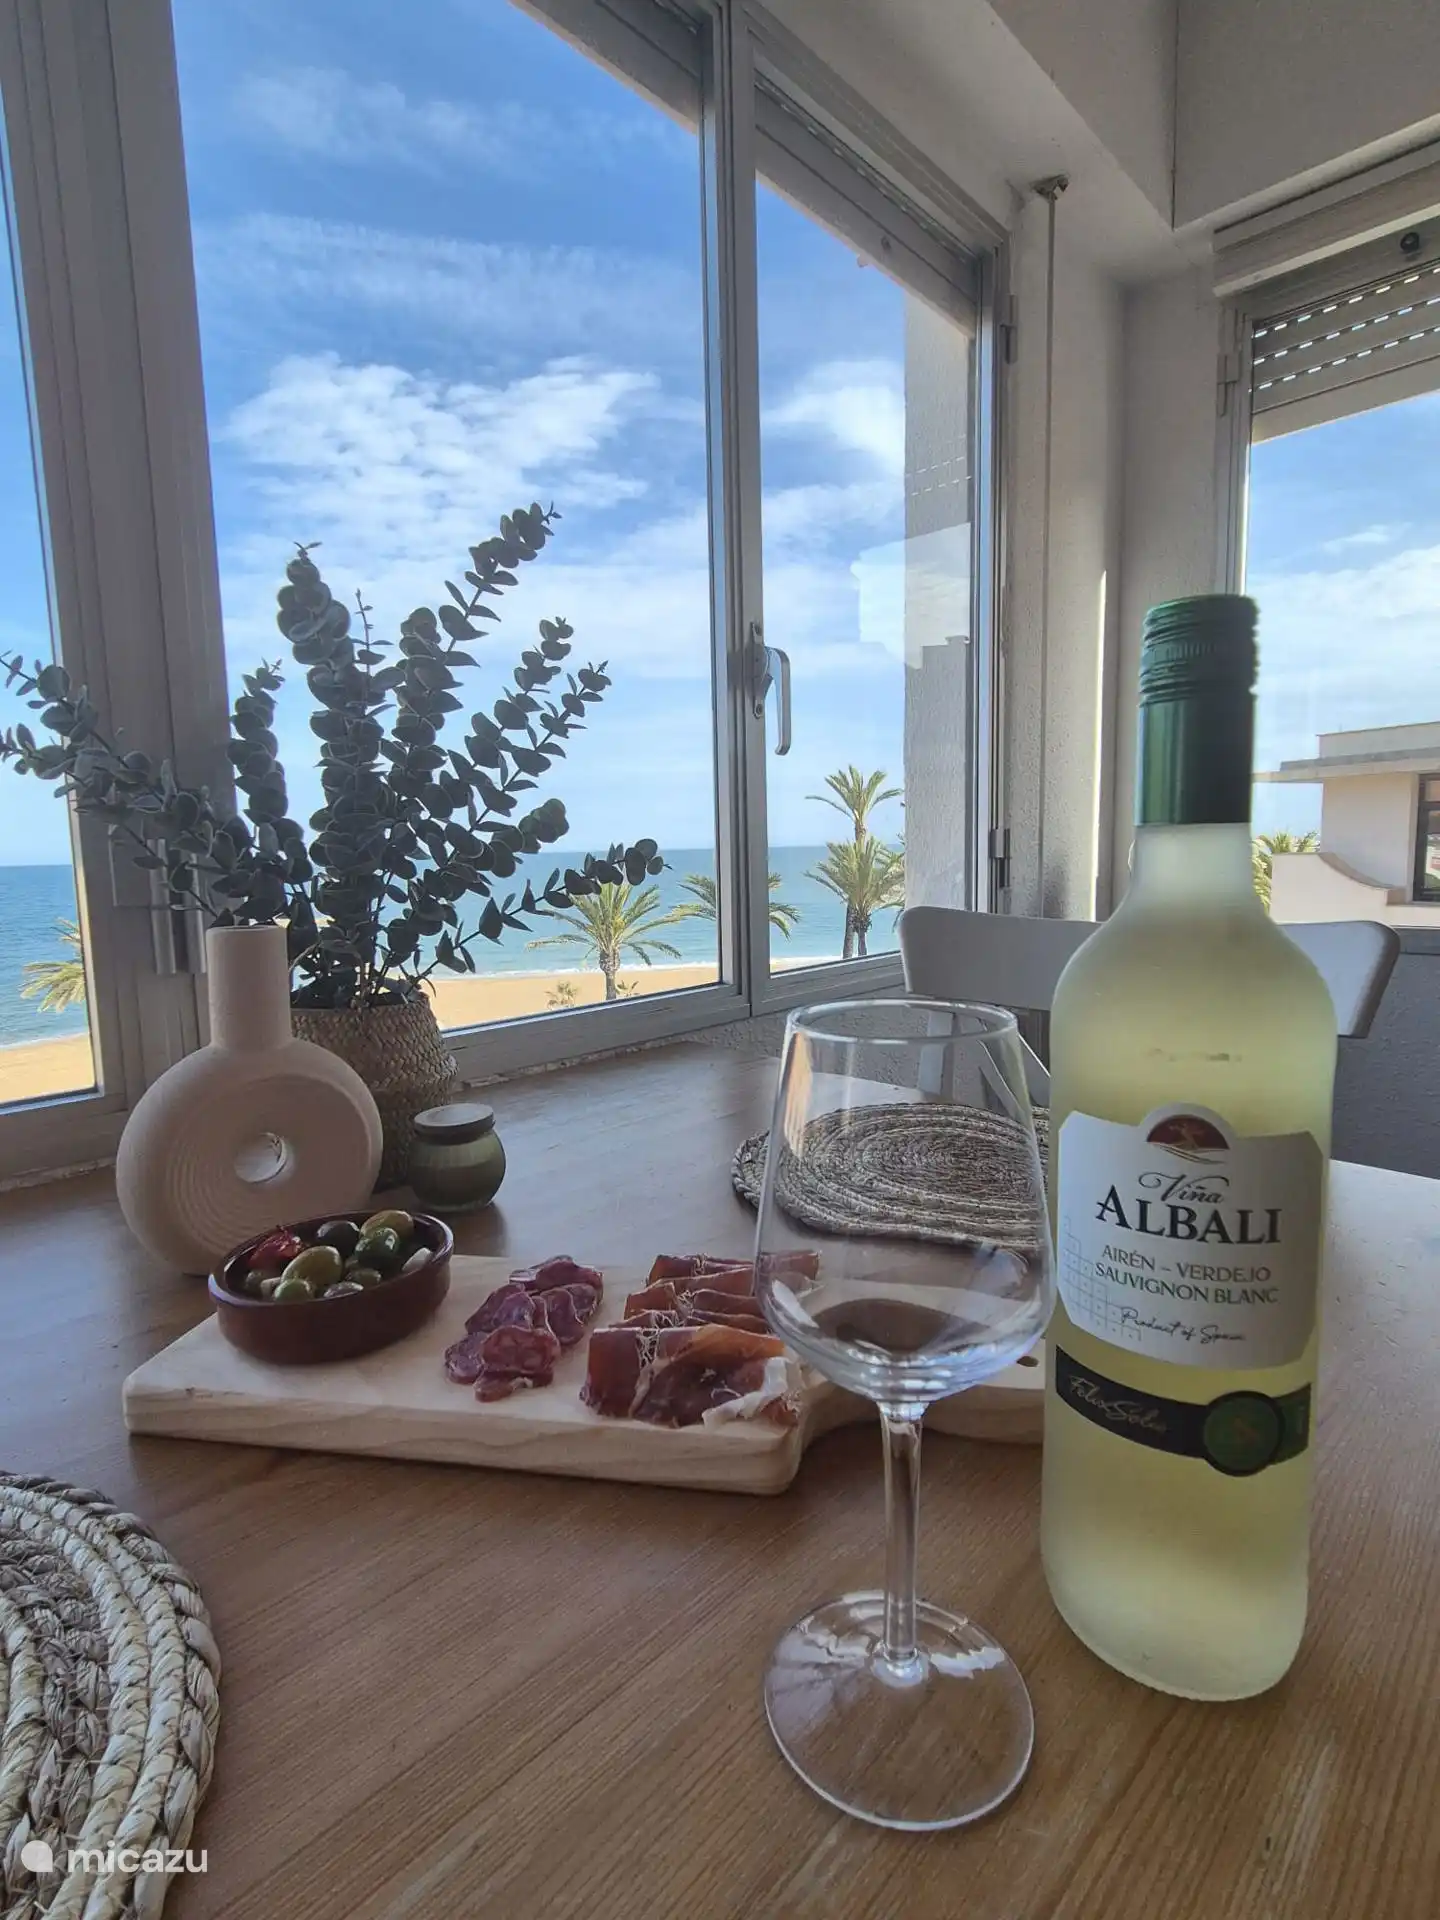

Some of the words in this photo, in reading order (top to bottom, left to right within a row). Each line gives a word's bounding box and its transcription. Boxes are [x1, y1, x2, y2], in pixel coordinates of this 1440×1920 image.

[1138, 1172, 1229, 1203] Viña
[1095, 1184, 1282, 1244] ALBALI
[1102, 1245, 1155, 1271] AIRÉN
[1176, 1262, 1271, 1283] VERDEJO
[1095, 1262, 1209, 1302] SAUVIGNON
[1214, 1285, 1279, 1305] BLANC
[1119, 1306, 1183, 1337] Product
